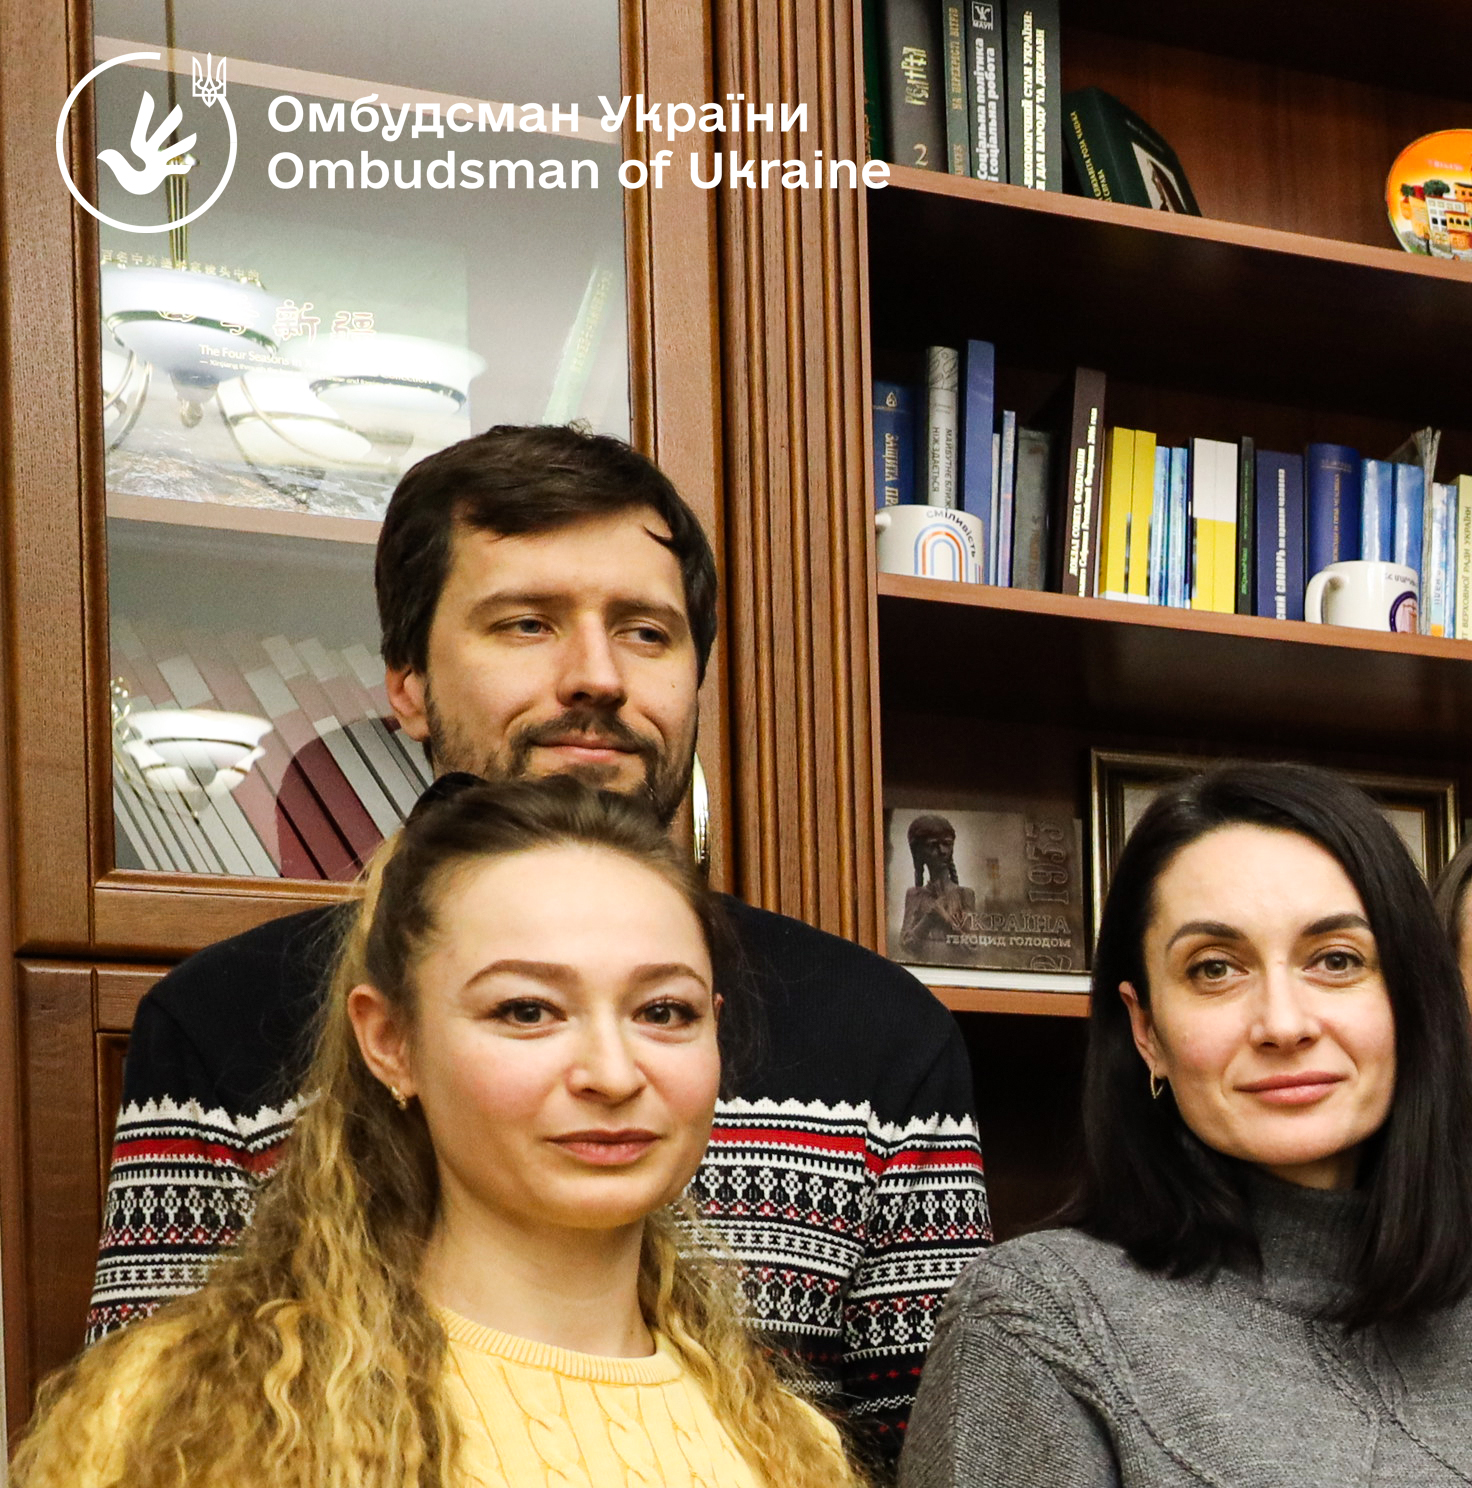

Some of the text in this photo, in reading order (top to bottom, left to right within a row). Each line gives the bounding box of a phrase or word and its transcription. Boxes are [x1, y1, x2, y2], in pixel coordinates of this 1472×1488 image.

[985, 47, 999, 101] робота
[1035, 29, 1046, 87] ДЕРЖАВИ
[1023, 66, 1033, 98] СТАН
[1036, 86, 1046, 103] ТА
[974, 37, 989, 181] Соціальна політика
[1036, 105, 1046, 153] НАРОДУ
[913, 143, 928, 167] 2
[987, 101, 1000, 174] соціальна
[1036, 154, 1046, 180] ДЛЯ
[200, 345, 220, 358] The
[222, 347, 246, 361] Four
[883, 432, 899, 483] ЗАЩИТА
[1464, 506, 1472, 545] УКРАЇНИ
[1276, 549, 1286, 593] СЛОВАРЬ
[1463, 549, 1471, 573] РАДИ
[1461, 575, 1470, 629] ВЕРХОВНОЇ
[951, 910, 1072, 933] УКРАЇНА
